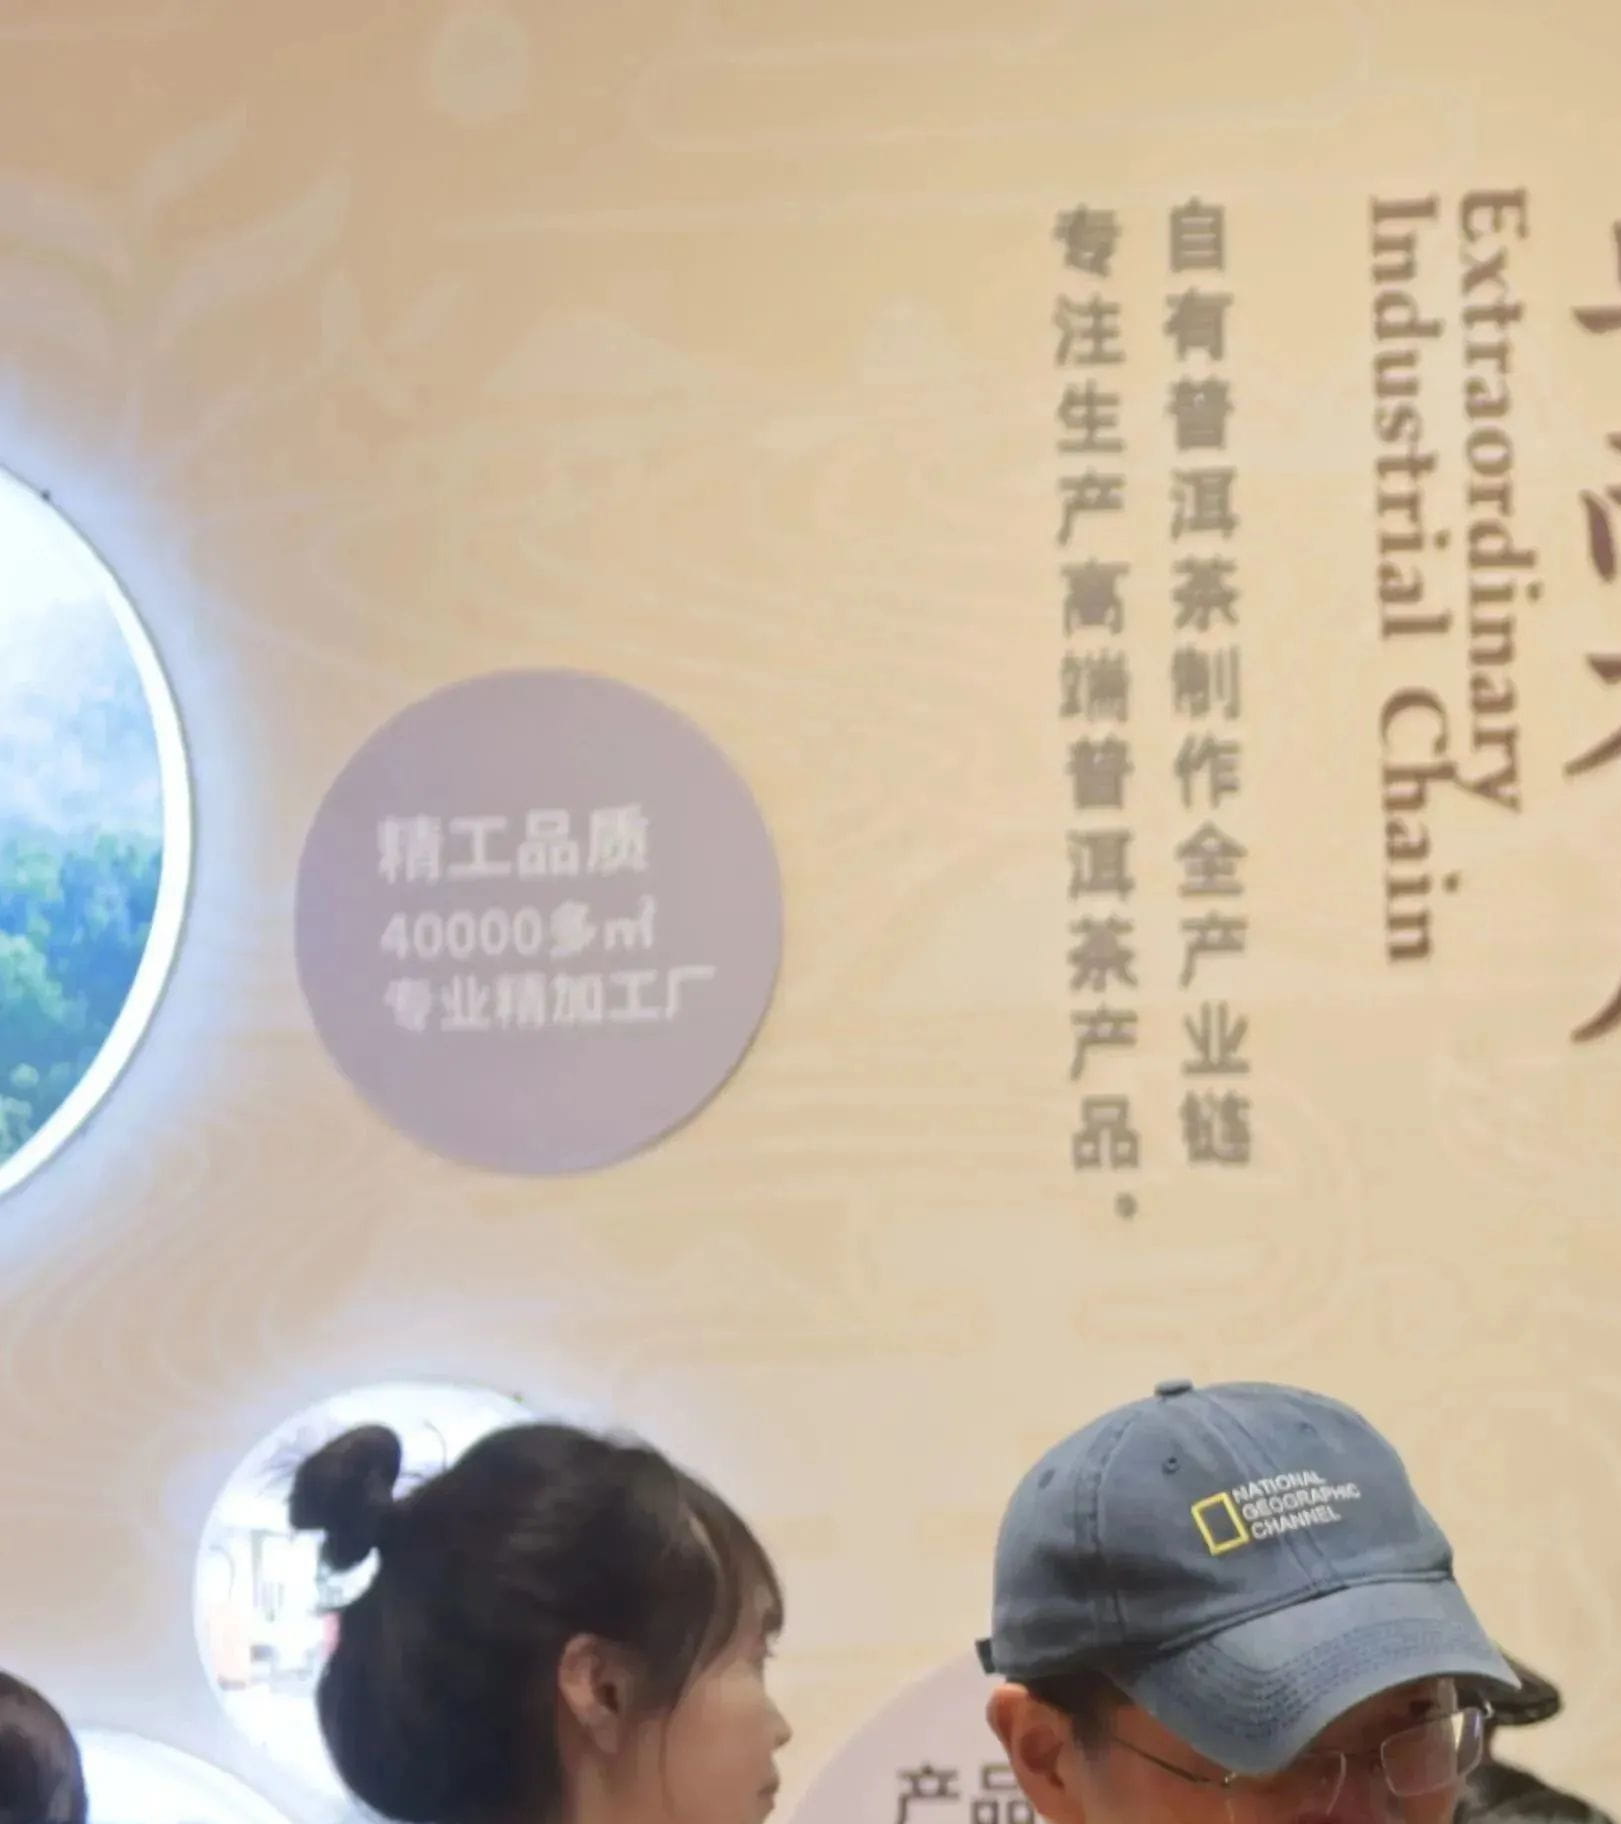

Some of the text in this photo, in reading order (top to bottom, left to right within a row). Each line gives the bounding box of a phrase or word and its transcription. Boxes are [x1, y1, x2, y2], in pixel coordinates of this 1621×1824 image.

[1459, 187, 1544, 813] Extraordinary
[1369, 196, 1460, 963] Industrial Chain
[1164, 197, 1253, 1170] 自有普洱茶制作全产业链
[377, 804, 650, 885] 精工品质
[385, 966, 716, 1032] 专业精加工厂
[1232, 1470, 1327, 1503] NATIONAL
[1242, 1483, 1361, 1521] GEOGRAPHIC
[1251, 1505, 1341, 1540] CHANNEL
